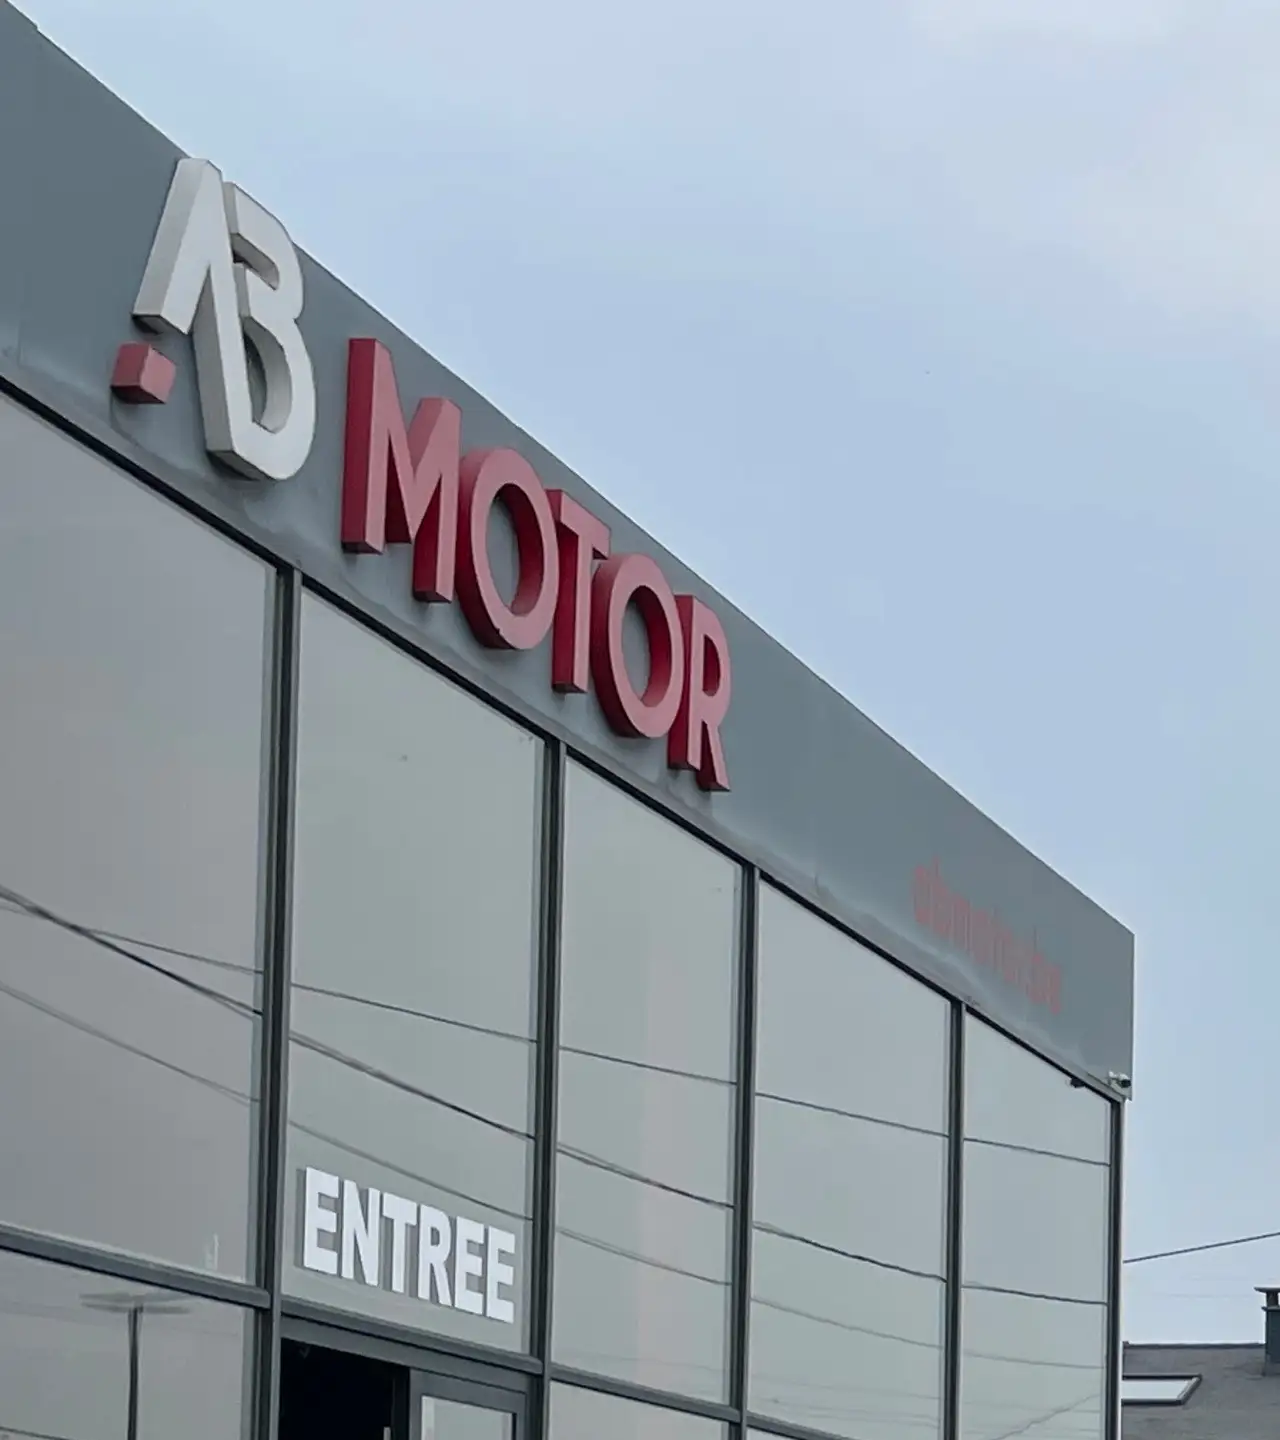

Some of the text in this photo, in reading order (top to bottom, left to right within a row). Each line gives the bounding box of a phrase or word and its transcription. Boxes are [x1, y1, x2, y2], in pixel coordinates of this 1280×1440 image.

[131, 156, 732, 792] AB MOTOR
[303, 1166, 516, 1325] ENTREE
